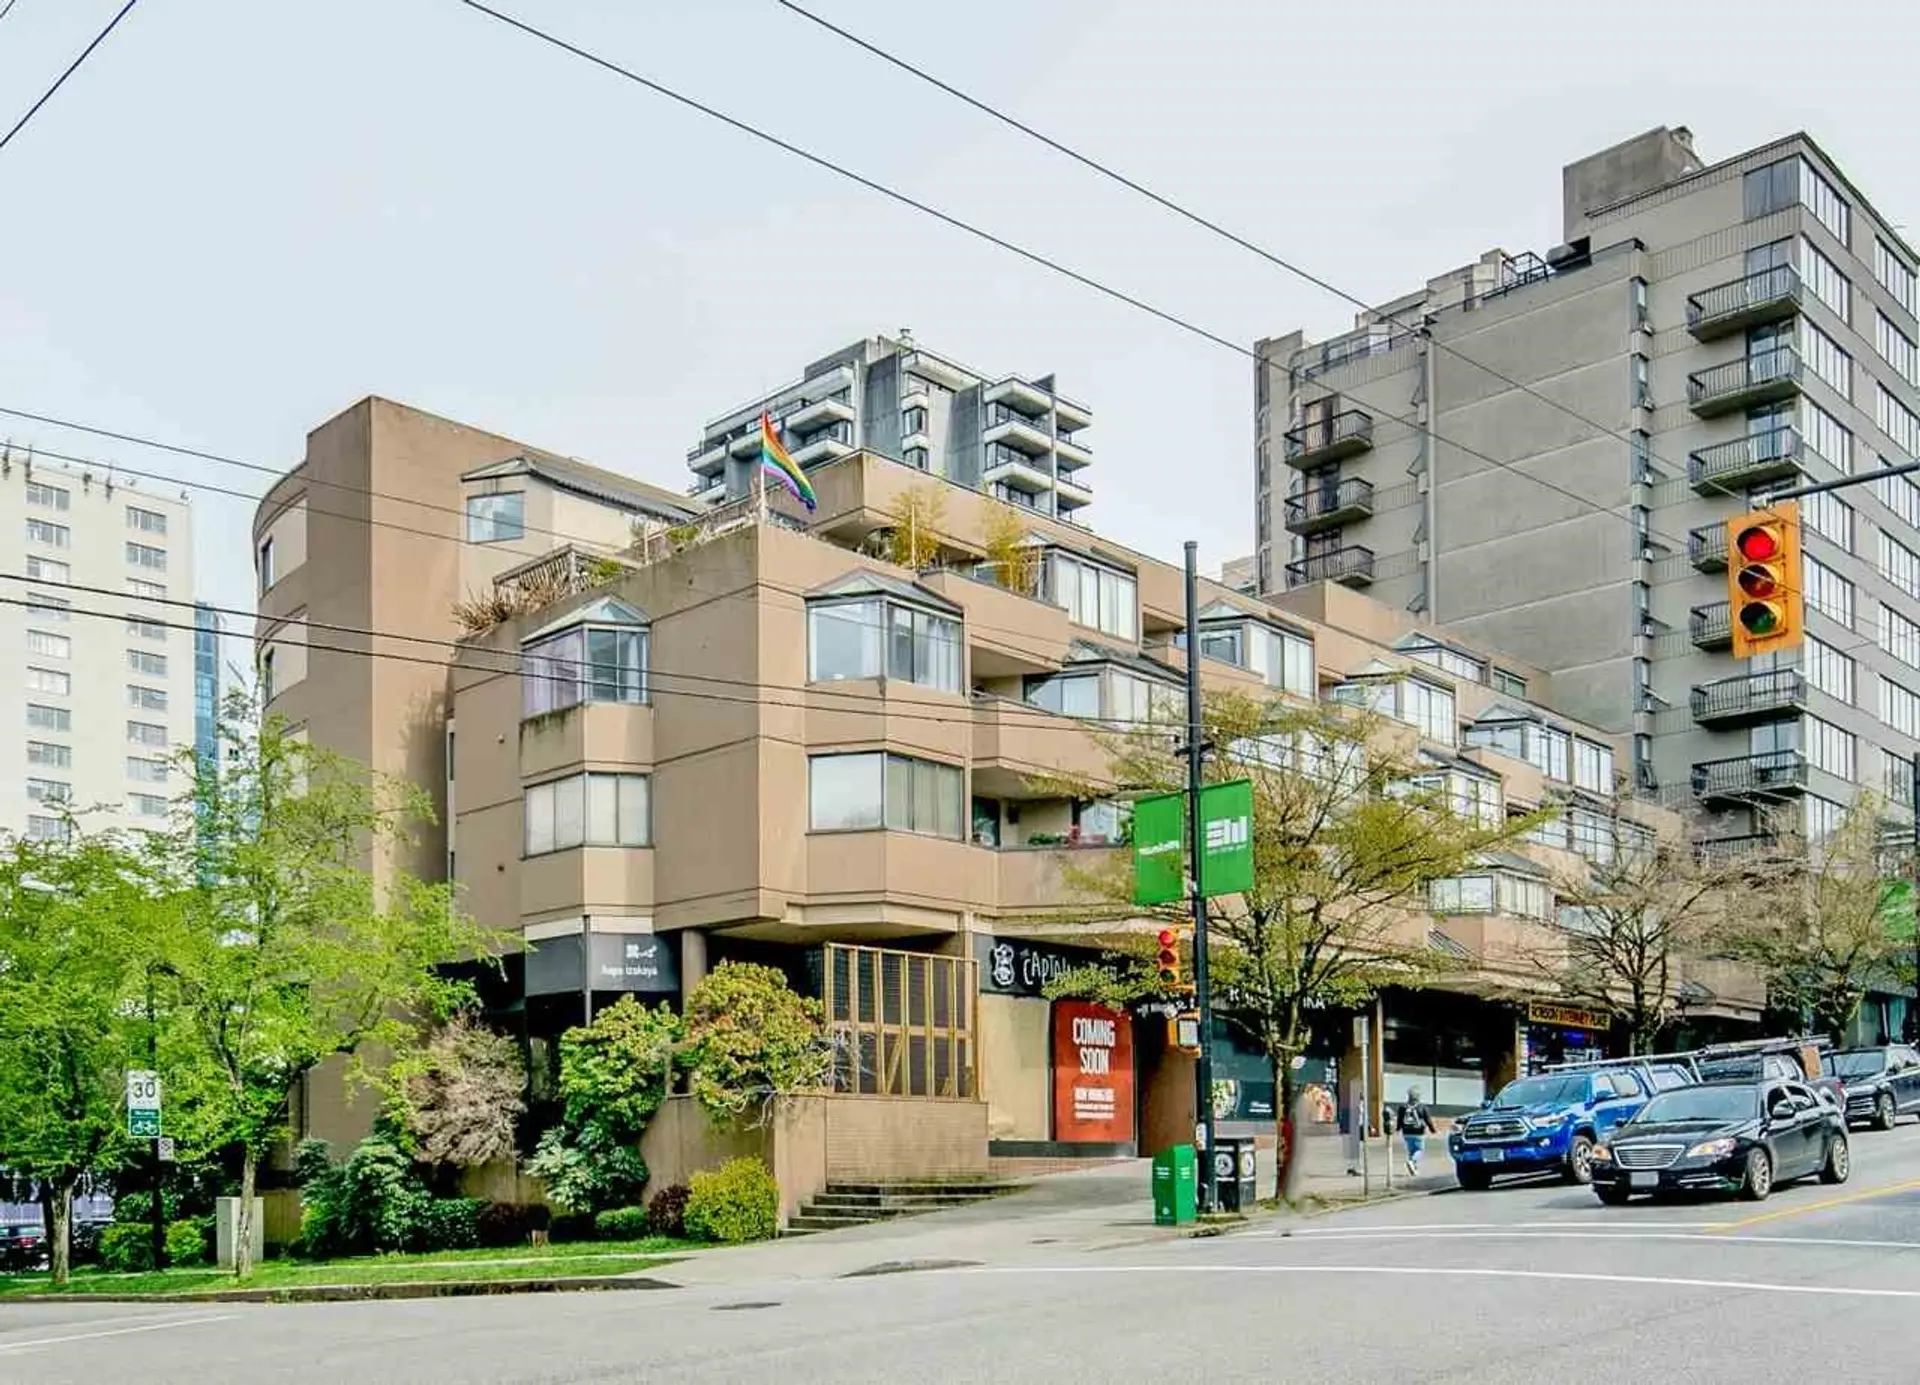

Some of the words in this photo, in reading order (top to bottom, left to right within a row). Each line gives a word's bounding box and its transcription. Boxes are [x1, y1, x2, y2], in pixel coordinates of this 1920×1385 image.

[1073, 1017, 1115, 1048] COMING
[1080, 1047, 1109, 1075] SOON
[132, 1081, 155, 1098] 30
